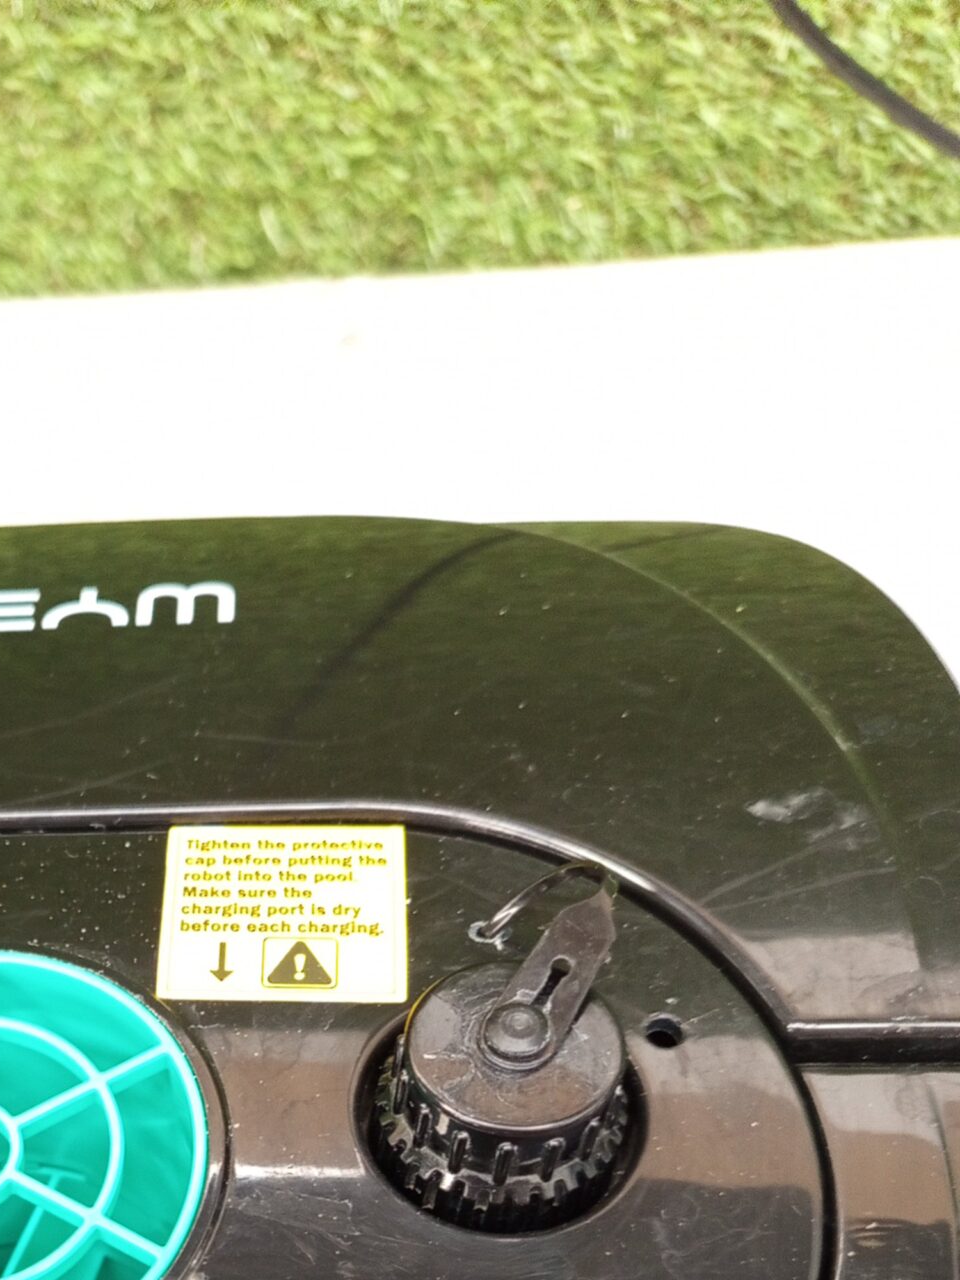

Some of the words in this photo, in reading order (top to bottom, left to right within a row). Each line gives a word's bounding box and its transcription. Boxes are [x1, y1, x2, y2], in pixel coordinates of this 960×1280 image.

[187, 839, 251, 851] Tighten
[257, 840, 285, 849] the
[292, 840, 383, 851] protective
[185, 857, 216, 867] cap
[223, 855, 281, 865] before
[288, 856, 352, 867] putting
[359, 857, 387, 865] the
[184, 871, 231, 881] robot
[238, 871, 271, 881] into
[279, 872, 307, 881] the
[183, 887, 231, 898] Make
[238, 889, 277, 898] sure
[284, 888, 312, 898] the
[181, 904, 261, 917] charging
[267, 905, 303, 917] port
[311, 905, 325, 914] is
[333, 905, 361, 918] dry
[180, 920, 239, 932] before
[247, 921, 290, 932] each
[298, 922, 384, 936] charging.
